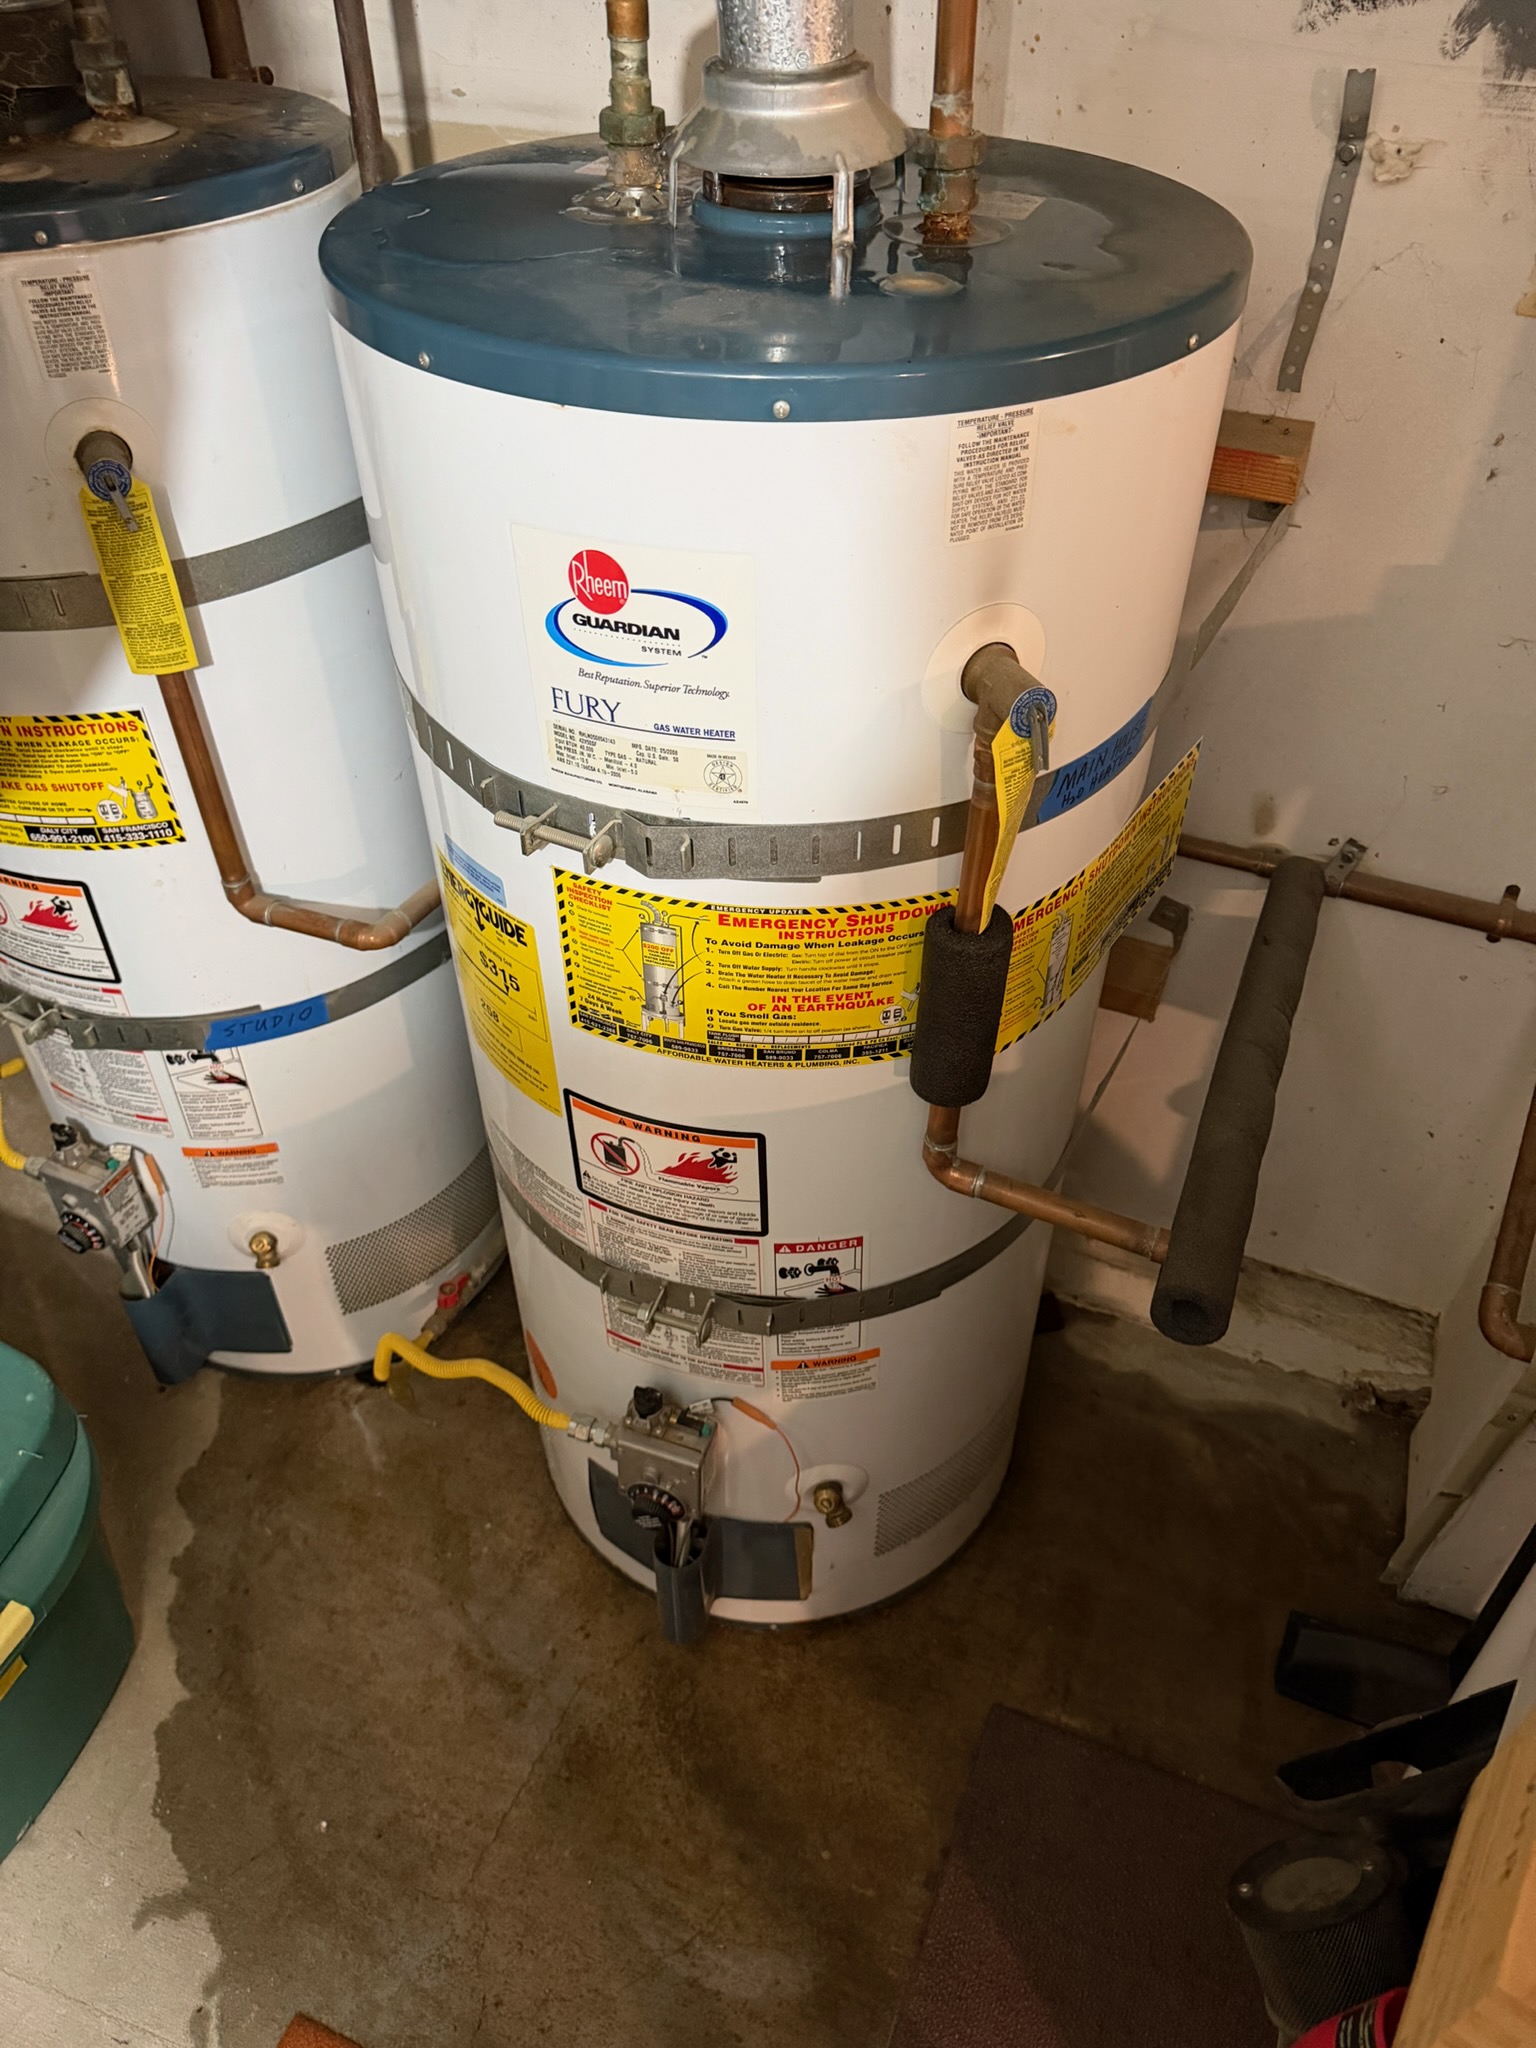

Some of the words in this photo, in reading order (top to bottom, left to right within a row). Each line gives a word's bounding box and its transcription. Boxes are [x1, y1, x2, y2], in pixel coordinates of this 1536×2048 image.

[957, 414, 999, 426] TEMPERATURE
[1004, 407, 1034, 418] PRESSURE
[976, 422, 996, 431] RELIEF
[998, 420, 1014, 428] VALVE
[958, 441, 981, 449] FOLLOW
[994, 431, 1030, 442] MAINTENANCE
[961, 445, 996, 455] PROCEDURES
[1009, 439, 1026, 447] RELIEF
[964, 457, 999, 468] INSTRUCTION
[1000, 452, 1021, 461] MANUAL
[571, 551, 628, 601] Rheem
[573, 613, 680, 640] GUARDIAN
[641, 645, 682, 656] SYSTEM
[578, 668, 595, 679] Best
[595, 672, 642, 688] Reputation.
[643, 680, 681, 693] Superior
[683, 684, 730, 700] Technology.
[551, 687, 622, 723] FURY
[16, 720, 139, 737] INSTRUCTIONS
[653, 723, 670, 732] GAS
[672, 725, 701, 736] WATER
[703, 729, 736, 738] HEATER
[45, 740, 91, 748] LEAKAGE
[95, 736, 139, 745] OCCURS:
[1057, 747, 1108, 798] MAIN
[1, 780, 22, 790] AKE
[25, 782, 48, 792] GAS
[50, 782, 105, 792] SHUTOFF
[101, 827, 120, 835] SAN
[122, 822, 169, 833] FRANCISCO
[103, 828, 173, 843] 415-333-1110
[4, 875, 39, 890] RNING
[1013, 878, 1086, 933] MERGENCY
[1088, 821, 1137, 882] SHUTDOWN
[566, 886, 613, 906] INSPECTION
[572, 882, 602, 896] SAFETY
[568, 894, 611, 912] CHECKLIST
[711, 905, 765, 914] EMERGENCY
[718, 914, 839, 930] EMERGENCY
[778, 924, 894, 940] INSTRUCTIONS
[705, 937, 718, 945] To
[721, 940, 752, 948] Avoid
[755, 942, 801, 950] Damage
[804, 941, 835, 949] When
[838, 937, 884, 948] Leakage
[479, 950, 521, 992] $315
[747, 1003, 767, 1012] OF
[772, 1004, 792, 1012] AN
[797, 996, 895, 1012] EARTHQUAKE
[792, 995, 821, 1004] THE
[826, 991, 873, 1002] EVENT
[224, 1005, 313, 1038] STUDIO
[739, 1012, 769, 1020] Smell
[772, 1013, 797, 1021] Gas:
[863, 1042, 888, 1050] PACIFICA
[657, 1048, 712, 1063] AFFORDABLE
[713, 1056, 744, 1066] WATER
[633, 1121, 701, 1143] WARNING
[217, 1148, 256, 1157] WARNING
[635, 1181, 648, 1189] AND
[648, 1185, 683, 1199] EXPLOSION
[684, 1193, 710, 1202] HAZARD
[658, 1176, 695, 1190] Flammable
[696, 1184, 721, 1192] Vapors
[636, 1218, 657, 1229] SAFETY
[675, 1229, 699, 1238] BEFORE
[699, 1234, 733, 1243] OPERATING
[795, 1239, 859, 1253] DANGER
[812, 1355, 857, 1368] WARNING
